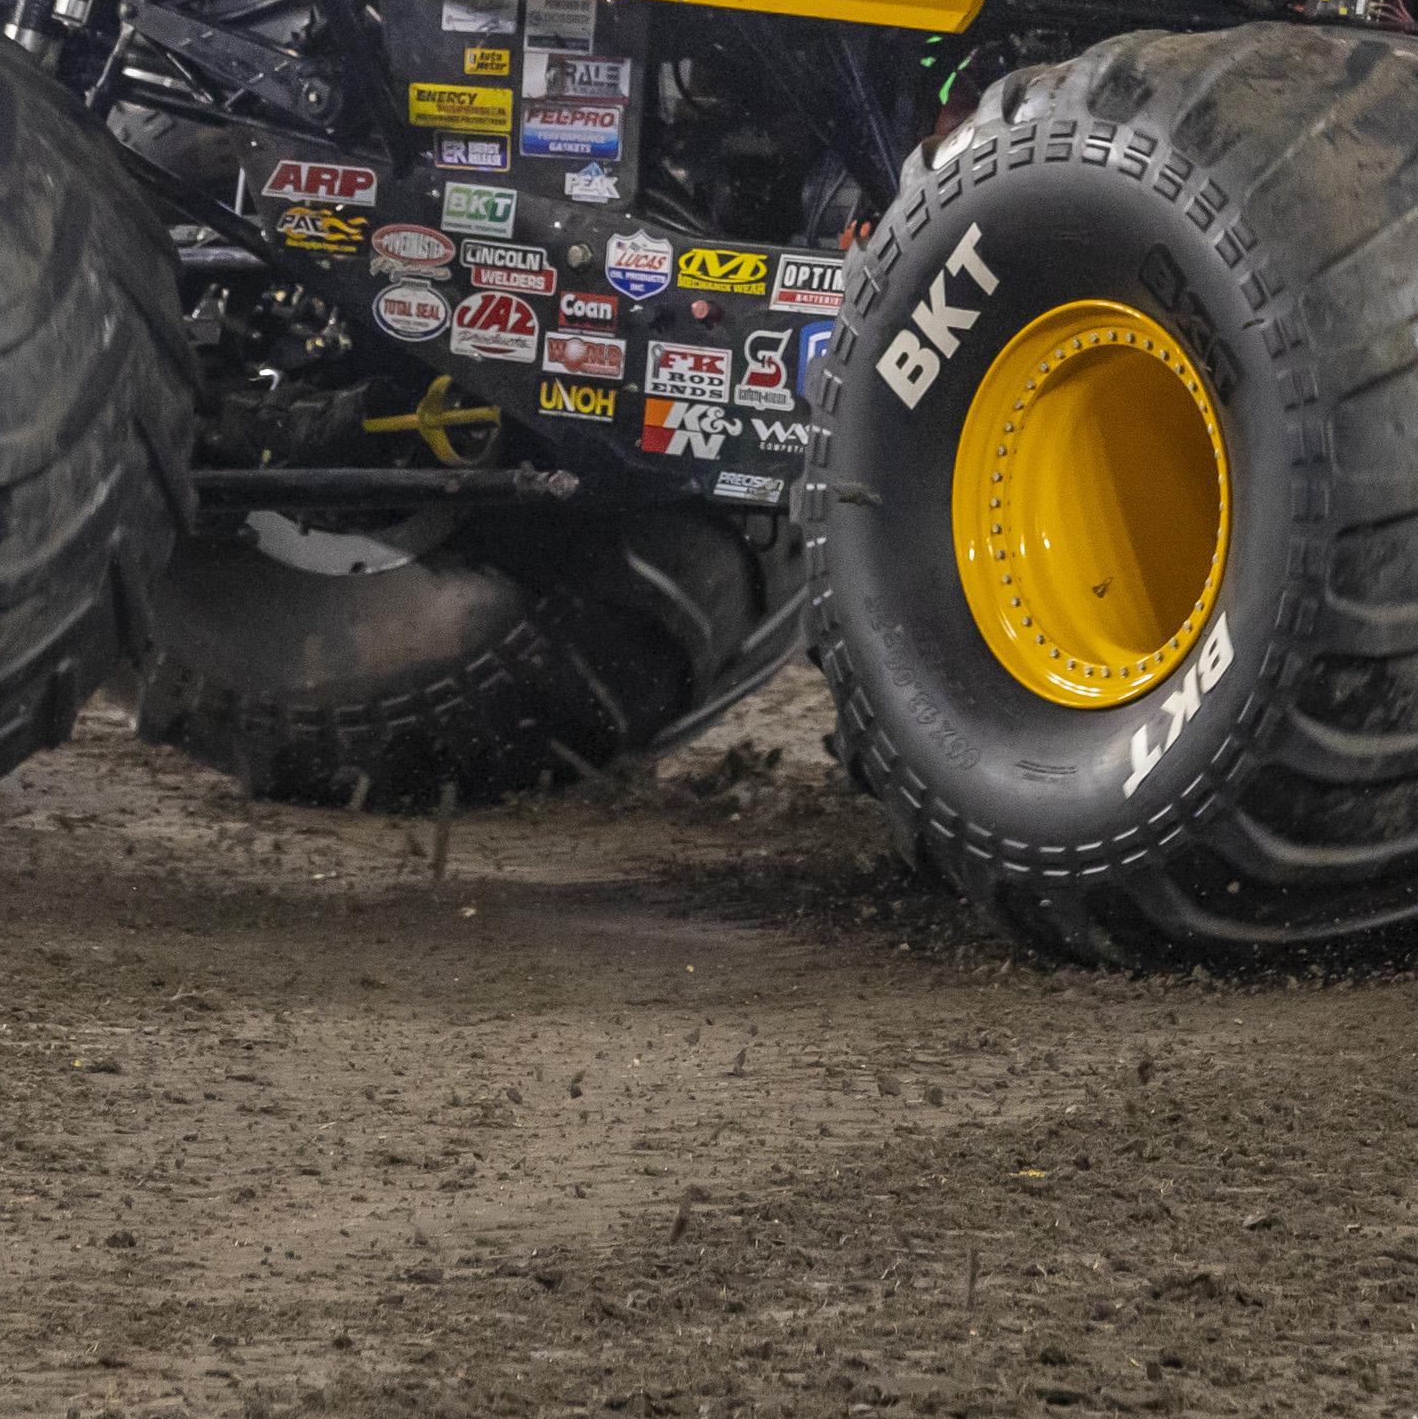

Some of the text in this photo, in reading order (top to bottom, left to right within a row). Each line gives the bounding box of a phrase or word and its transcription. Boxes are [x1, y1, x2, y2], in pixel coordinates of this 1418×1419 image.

[416, 89, 477, 106] ENERGY
[268, 164, 374, 197] ARP
[565, 172, 620, 198] PEAK
[447, 187, 515, 222] BKT
[465, 246, 542, 271] LINCOLN
[615, 249, 667, 270] LUCAS
[480, 269, 546, 291] WELDERS
[783, 264, 846, 291] OPTIM
[383, 298, 441, 321] TOTAL SEAL
[457, 293, 535, 335] JAZ
[560, 293, 613, 320] Coan
[875, 222, 1000, 410] BKT
[659, 350, 725, 375] FK
[651, 382, 724, 399] ENDS
[668, 371, 724, 387] ROD
[539, 379, 617, 417] UNOH
[1123, 611, 1235, 798] BKT
